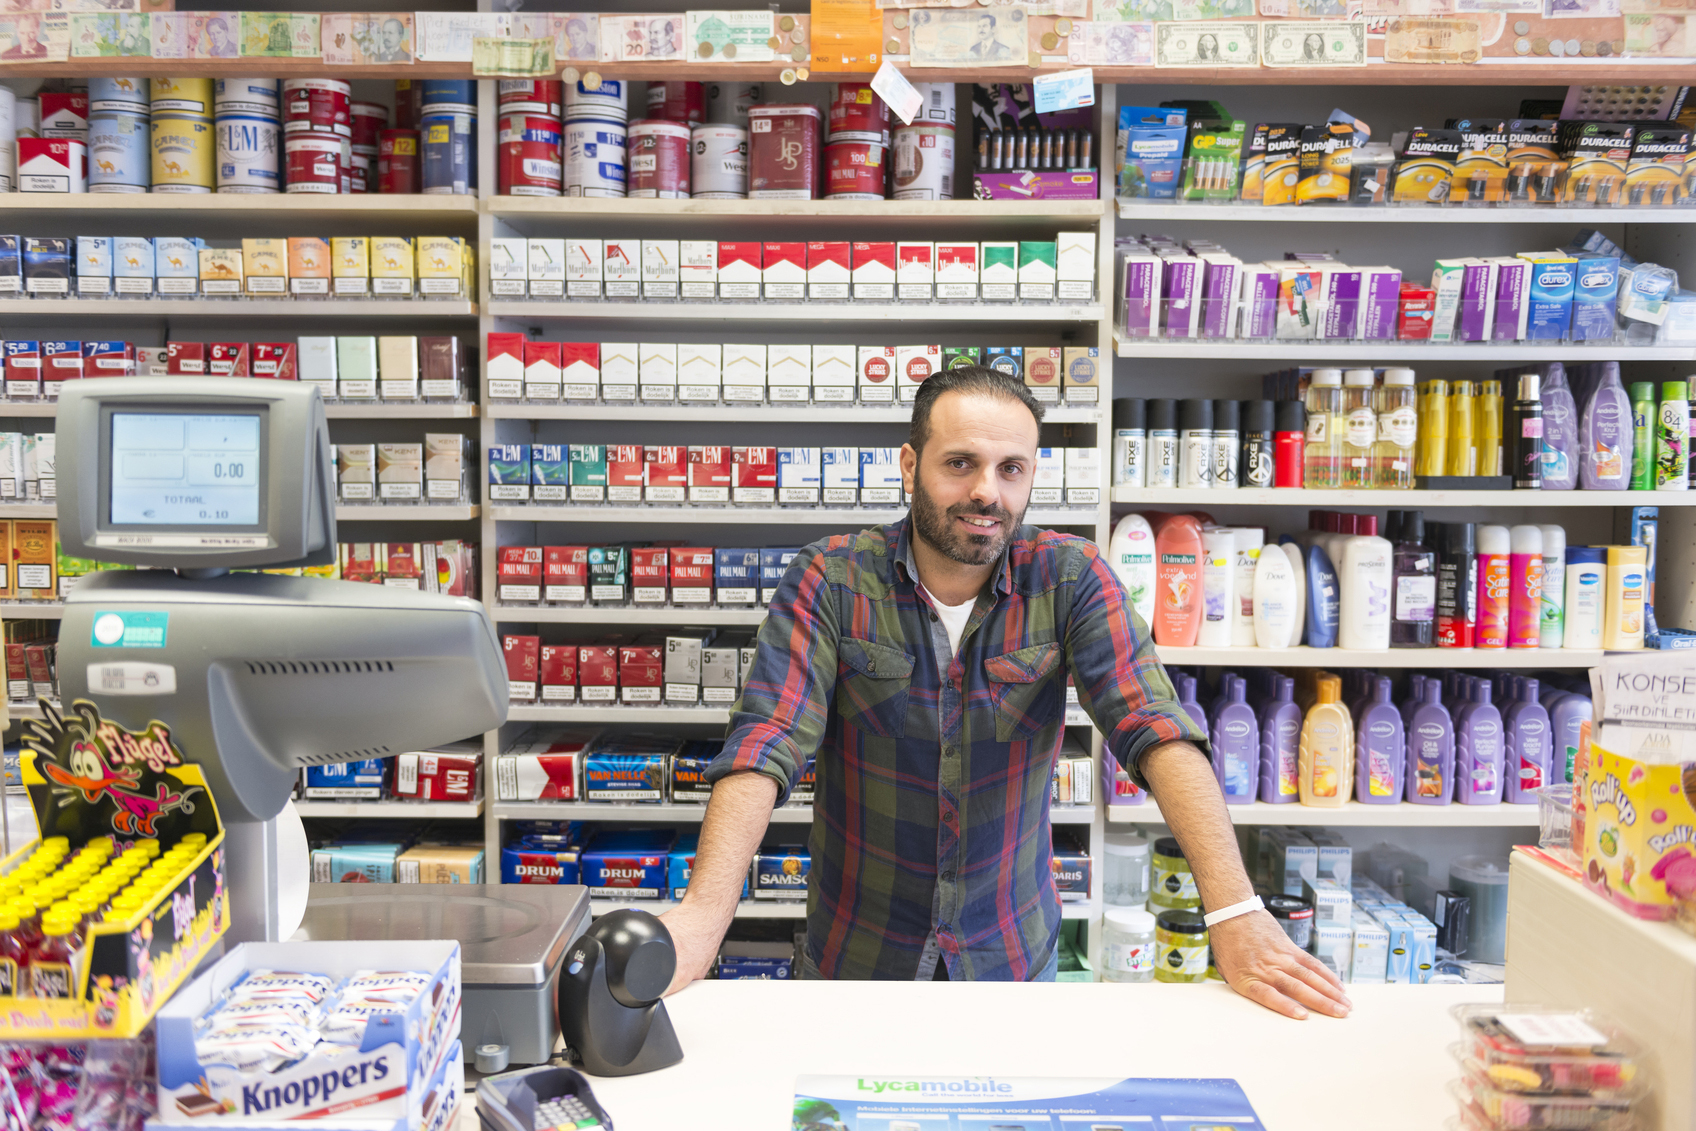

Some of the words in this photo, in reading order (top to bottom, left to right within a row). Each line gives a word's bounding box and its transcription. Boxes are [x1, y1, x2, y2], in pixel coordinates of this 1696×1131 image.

[626, 44, 644, 56] 20
[1193, 121, 1203, 129] AA
[154, 135, 198, 150] CAMEL
[228, 124, 257, 152] L&M
[1193, 136, 1216, 150] GP
[1216, 136, 1241, 148] Super
[1510, 134, 1558, 145] DURACELL
[1580, 137, 1632, 148] DURACELL
[1134, 142, 1175, 152] Lycamobile
[1302, 140, 1351, 153] DURAELL
[1409, 141, 1459, 153] DURACELL
[1635, 144, 1688, 154] DURACELL
[851, 153, 867, 163] 100
[1139, 152, 1168, 161] Prepaid
[1330, 156, 1350, 165] 2025
[568, 260, 599, 275] Marlboro
[606, 260, 638, 275] Marlboro
[645, 261, 676, 275] Marlboro
[1541, 274, 1569, 286] durex
[1142, 263, 1152, 309] PARACETAMOL
[1477, 266, 1491, 312] PARACETAMOL
[1511, 265, 1523, 312] PARACETAMOL
[1404, 301, 1428, 311] Rennie
[182, 361, 203, 371] West
[254, 362, 276, 372] West
[394, 447, 418, 456] KENT
[502, 444, 521, 462] L&M
[543, 444, 561, 462] L&M
[580, 445, 599, 463] L&M
[617, 445, 636, 463] L&M
[658, 446, 678, 464] L&M
[702, 446, 722, 464] L&M
[747, 446, 768, 464] L&M
[1128, 440, 1136, 466] AXE
[1163, 440, 1171, 466] AXE
[1200, 442, 1208, 467] AXE
[1217, 442, 1226, 468] AXE
[1249, 442, 1259, 469] AXE
[214, 462, 244, 479] 0,00
[164, 495, 207, 505] TOTAAL
[1122, 553, 1152, 564] Palmolive
[1162, 554, 1196, 565] Palmolive
[503, 564, 516, 575] PALL
[517, 564, 530, 575] MALL
[549, 564, 562, 575] PALL
[562, 564, 576, 575] MALL
[592, 563, 603, 574] PALL
[603, 563, 616, 574] MALL
[634, 565, 646, 576] PALL
[646, 565, 659, 576] MALL
[674, 566, 687, 577] PALL
[687, 566, 701, 577] MALL
[719, 566, 732, 578] PALL
[733, 566, 747, 578] MALL
[1265, 572, 1286, 581] Dove
[1318, 571, 1333, 581] Dove
[1624, 577, 1642, 585] Vaseline
[1486, 587, 1509, 600] Care
[1486, 638, 1503, 646] GEL
[1526, 638, 1539, 646] GEL
[1616, 672, 1696, 695] KONSE
[1653, 694, 1669, 705] VE
[1225, 725, 1248, 734] Andrélon
[1369, 725, 1394, 734] Andrélon
[1417, 726, 1444, 736] Andrélon
[1474, 725, 1497, 734] Andrélon
[1519, 723, 1544, 732] Andrélon
[97, 722, 180, 773] Flügel
[589, 770, 612, 782] VAN
[612, 770, 647, 782] NELLE
[675, 771, 697, 782] VAN
[446, 769, 470, 795] L&M
[626, 791, 658, 800] dodelijk
[1288, 848, 1317, 856] PHILIPS
[1320, 848, 1351, 856] PHILIPS
[515, 864, 566, 878] DRUM
[599, 866, 647, 880] DRUM
[591, 888, 611, 896] Roken
[615, 888, 624, 896] is
[626, 888, 657, 897] dodelijk
[1319, 896, 1350, 905] PHILIPS
[1320, 932, 1352, 941] PHILIPS
[1357, 933, 1388, 942] PHILIPS
[242, 1054, 390, 1116] Knoppers
[857, 1077, 1014, 1094] Lycamobile
[900, 1105, 1004, 1115] Internetinstellingen
[1050, 1107, 1099, 1115] telefoon:
